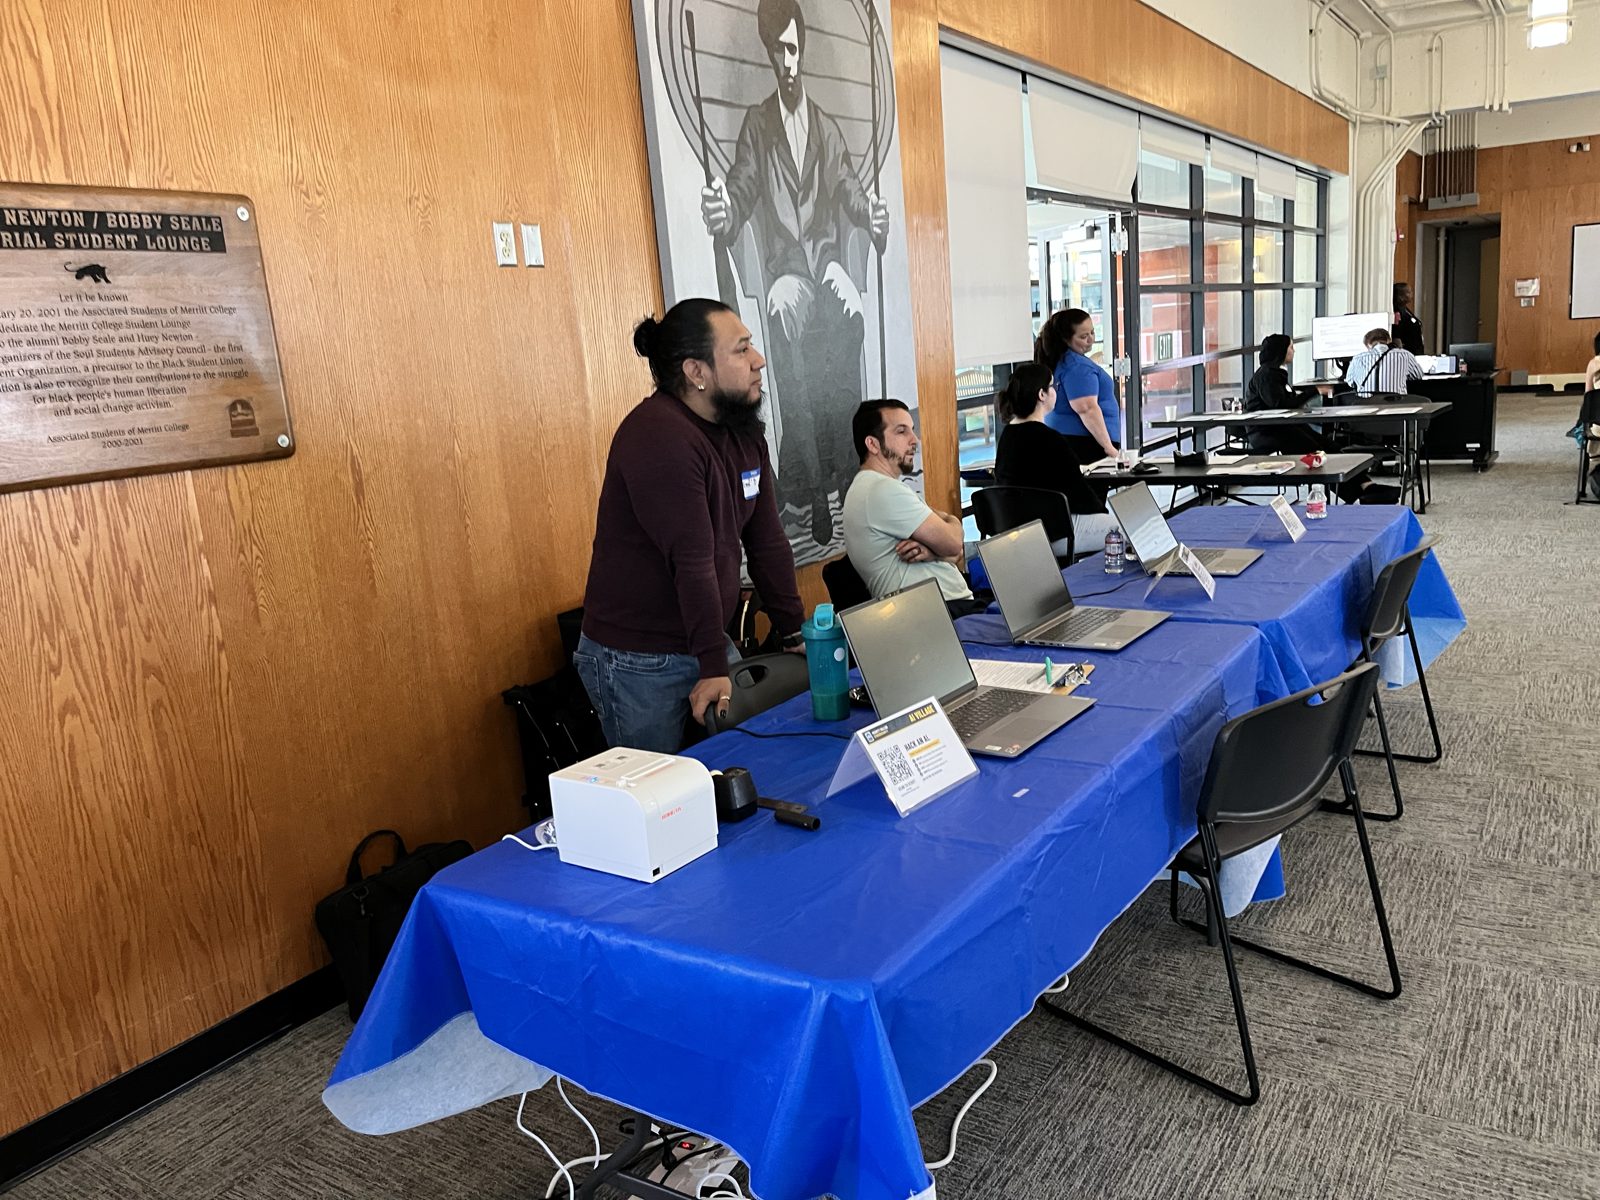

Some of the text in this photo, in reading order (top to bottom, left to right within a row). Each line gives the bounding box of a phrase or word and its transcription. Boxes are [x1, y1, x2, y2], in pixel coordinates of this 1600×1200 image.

[3, 209, 222, 232] NEWTON / BOBBY SEALE
[53, 232, 138, 250] STUDENT
[145, 235, 211, 252] LOUNGE
[59, 292, 129, 302] Let it be known
[38, 307, 60, 318] 2001
[64, 307, 79, 317] the
[82, 306, 128, 317] Associated
[130, 306, 167, 315] Students
[169, 306, 178, 314] of
[180, 305, 208, 315] Merritt
[209, 305, 237, 315] College
[40, 322, 56, 332] the
[58, 321, 90, 331] Merritt
[91, 320, 123, 332] College
[125, 320, 159, 330] Student
[160, 319, 191, 330] Lounge
[8, 338, 24, 348] the
[26, 336, 60, 347] alumni
[61, 335, 90, 347] Bobby
[92, 334, 115, 344] Seale
[118, 333, 135, 343] and
[137, 333, 159, 344] Huey
[161, 333, 194, 341] Newton
[44, 350, 54, 360] of
[56, 350, 72, 360] the
[73, 349, 94, 359] Soul
[96, 348, 135, 359] Students
[138, 346, 174, 357] Advisory
[176, 345, 206, 355] Council
[213, 344, 226, 353] the
[228, 343, 244, 352] first
[83, 365, 90, 373] a
[92, 362, 133, 374] precursor
[135, 361, 144, 370] to
[146, 360, 160, 369] the
[162, 358, 185, 369] Black
[187, 357, 218, 368] Student
[23, 380, 32, 391] is
[34, 379, 54, 390] also
[56, 379, 66, 388] to
[68, 376, 111, 389] recognize
[112, 375, 133, 385] their
[135, 372, 191, 384] contributions
[193, 371, 202, 380] to
[203, 370, 216, 380] the
[218, 368, 249, 380] struggle
[32, 386, 187, 405] for black people's human liberation
[54, 400, 174, 417] and social change activism.
[47, 423, 190, 443] Associated Students of Merritt College
[102, 438, 143, 449] 2000-2001
[914, 704, 936, 720] VILLAGE
